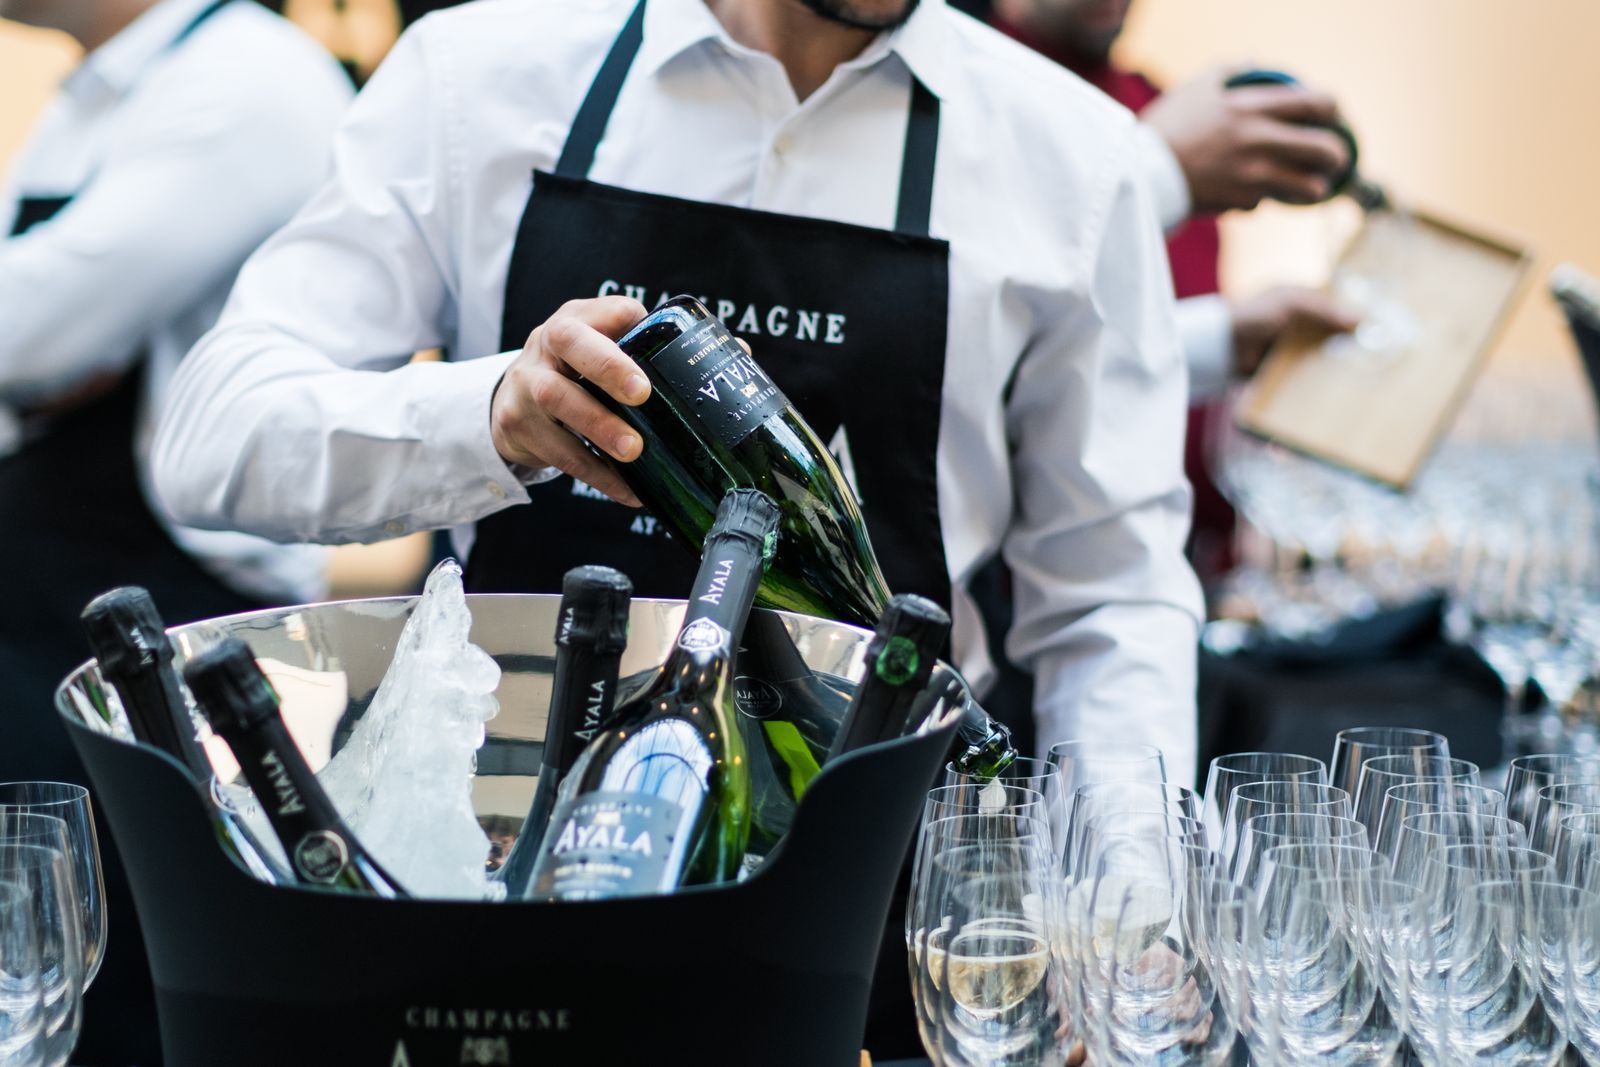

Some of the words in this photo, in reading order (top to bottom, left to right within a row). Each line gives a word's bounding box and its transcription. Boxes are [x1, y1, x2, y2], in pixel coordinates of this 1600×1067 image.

[597, 280, 847, 344] CHPAGNE
[699, 355, 770, 402] AYALA
[734, 386, 777, 421] CHAMPAGNE
[699, 560, 734, 605] AYALA
[560, 607, 574, 645] AYALA
[574, 680, 606, 741] AYALA
[261, 750, 305, 817] AYALA
[553, 818, 652, 856] AYALA
[406, 1006, 571, 1030] CHAMPAGNE
